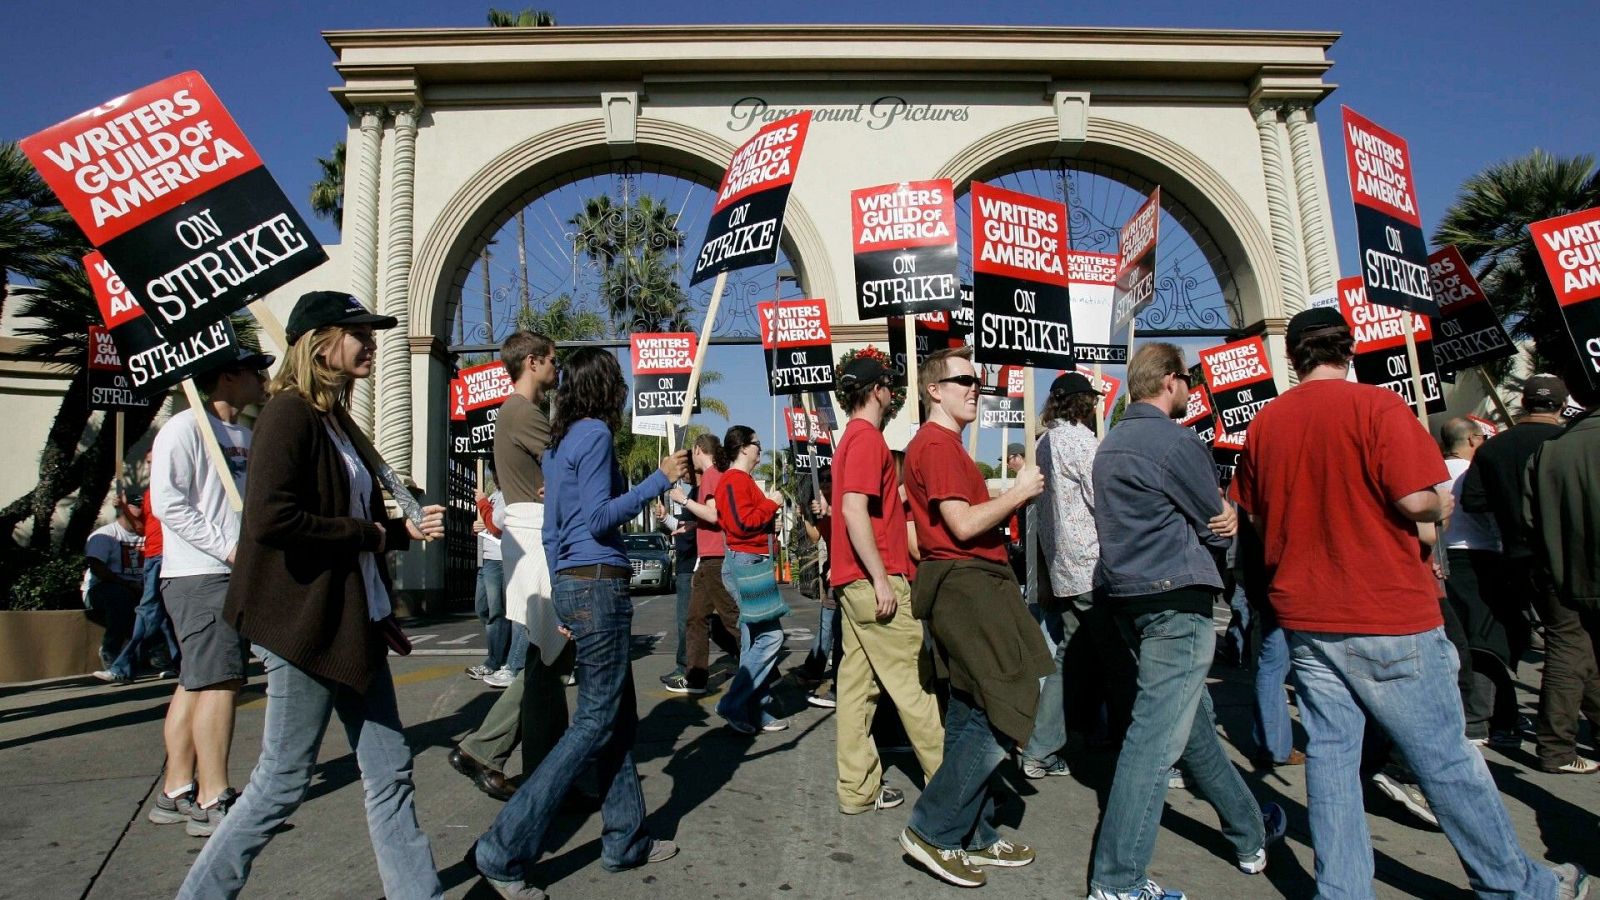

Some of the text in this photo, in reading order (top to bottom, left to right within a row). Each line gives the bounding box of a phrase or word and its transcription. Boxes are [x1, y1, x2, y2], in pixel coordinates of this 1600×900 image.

[867, 96, 970, 130] Pictures
[42, 90, 200, 172] WRITERS
[732, 123, 798, 167] WRITERS
[75, 120, 214, 194] GUILD OF
[1347, 122, 1404, 169] WRITERS
[727, 145, 791, 185] GUILD OF
[1355, 149, 1407, 190] GUILD OF
[89, 138, 245, 228] AMERICA
[718, 162, 791, 205] AMERICA
[1357, 172, 1416, 216] AMERICA
[858, 188, 943, 213] WRITERS
[978, 196, 1059, 233] WRITERS
[175, 208, 224, 250] ON
[728, 203, 750, 228] ON
[862, 206, 942, 226] GUILD OF
[1122, 200, 1156, 242] WRITERS
[696, 218, 776, 273] STRIKE
[859, 221, 950, 245] AMERICA
[984, 220, 1058, 253] GUILD OF
[1122, 228, 1146, 256] GUILD
[1385, 226, 1402, 254] ON
[1542, 220, 1600, 251] WRIT
[980, 243, 1064, 276] AMERICA
[1120, 230, 1155, 271] AMERICA
[146, 212, 309, 325] STRIKE
[892, 255, 917, 275] ON
[1128, 267, 1140, 288] ON
[1366, 249, 1433, 302] STRIKE
[862, 274, 955, 309] STRIKE
[1013, 288, 1036, 314] ON
[1116, 272, 1152, 324] STRIKE
[1436, 284, 1476, 308] RICA
[808, 320, 820, 328] OF
[980, 312, 1070, 356] STRIKE
[1354, 315, 1426, 343] AMERIA
[1440, 320, 1462, 337] ON
[128, 320, 230, 387] STRIKE
[636, 338, 690, 349] WRITERS
[639, 348, 677, 359] GUILD
[1074, 346, 1126, 360] TRIKE
[1204, 344, 1258, 366] WRITERS
[637, 358, 695, 369] AMERICA
[791, 352, 807, 366] ON
[1211, 356, 1260, 376] GUILD OF
[1387, 355, 1408, 376] ON
[468, 378, 499, 395] GUILD
[500, 378, 511, 387] OF
[658, 378, 674, 390] ON
[772, 365, 832, 388] STRIKE
[1212, 364, 1267, 387] AMERICA
[467, 385, 515, 405] AMERICA
[1000, 400, 1012, 409] ON
[1237, 389, 1254, 404] ON
